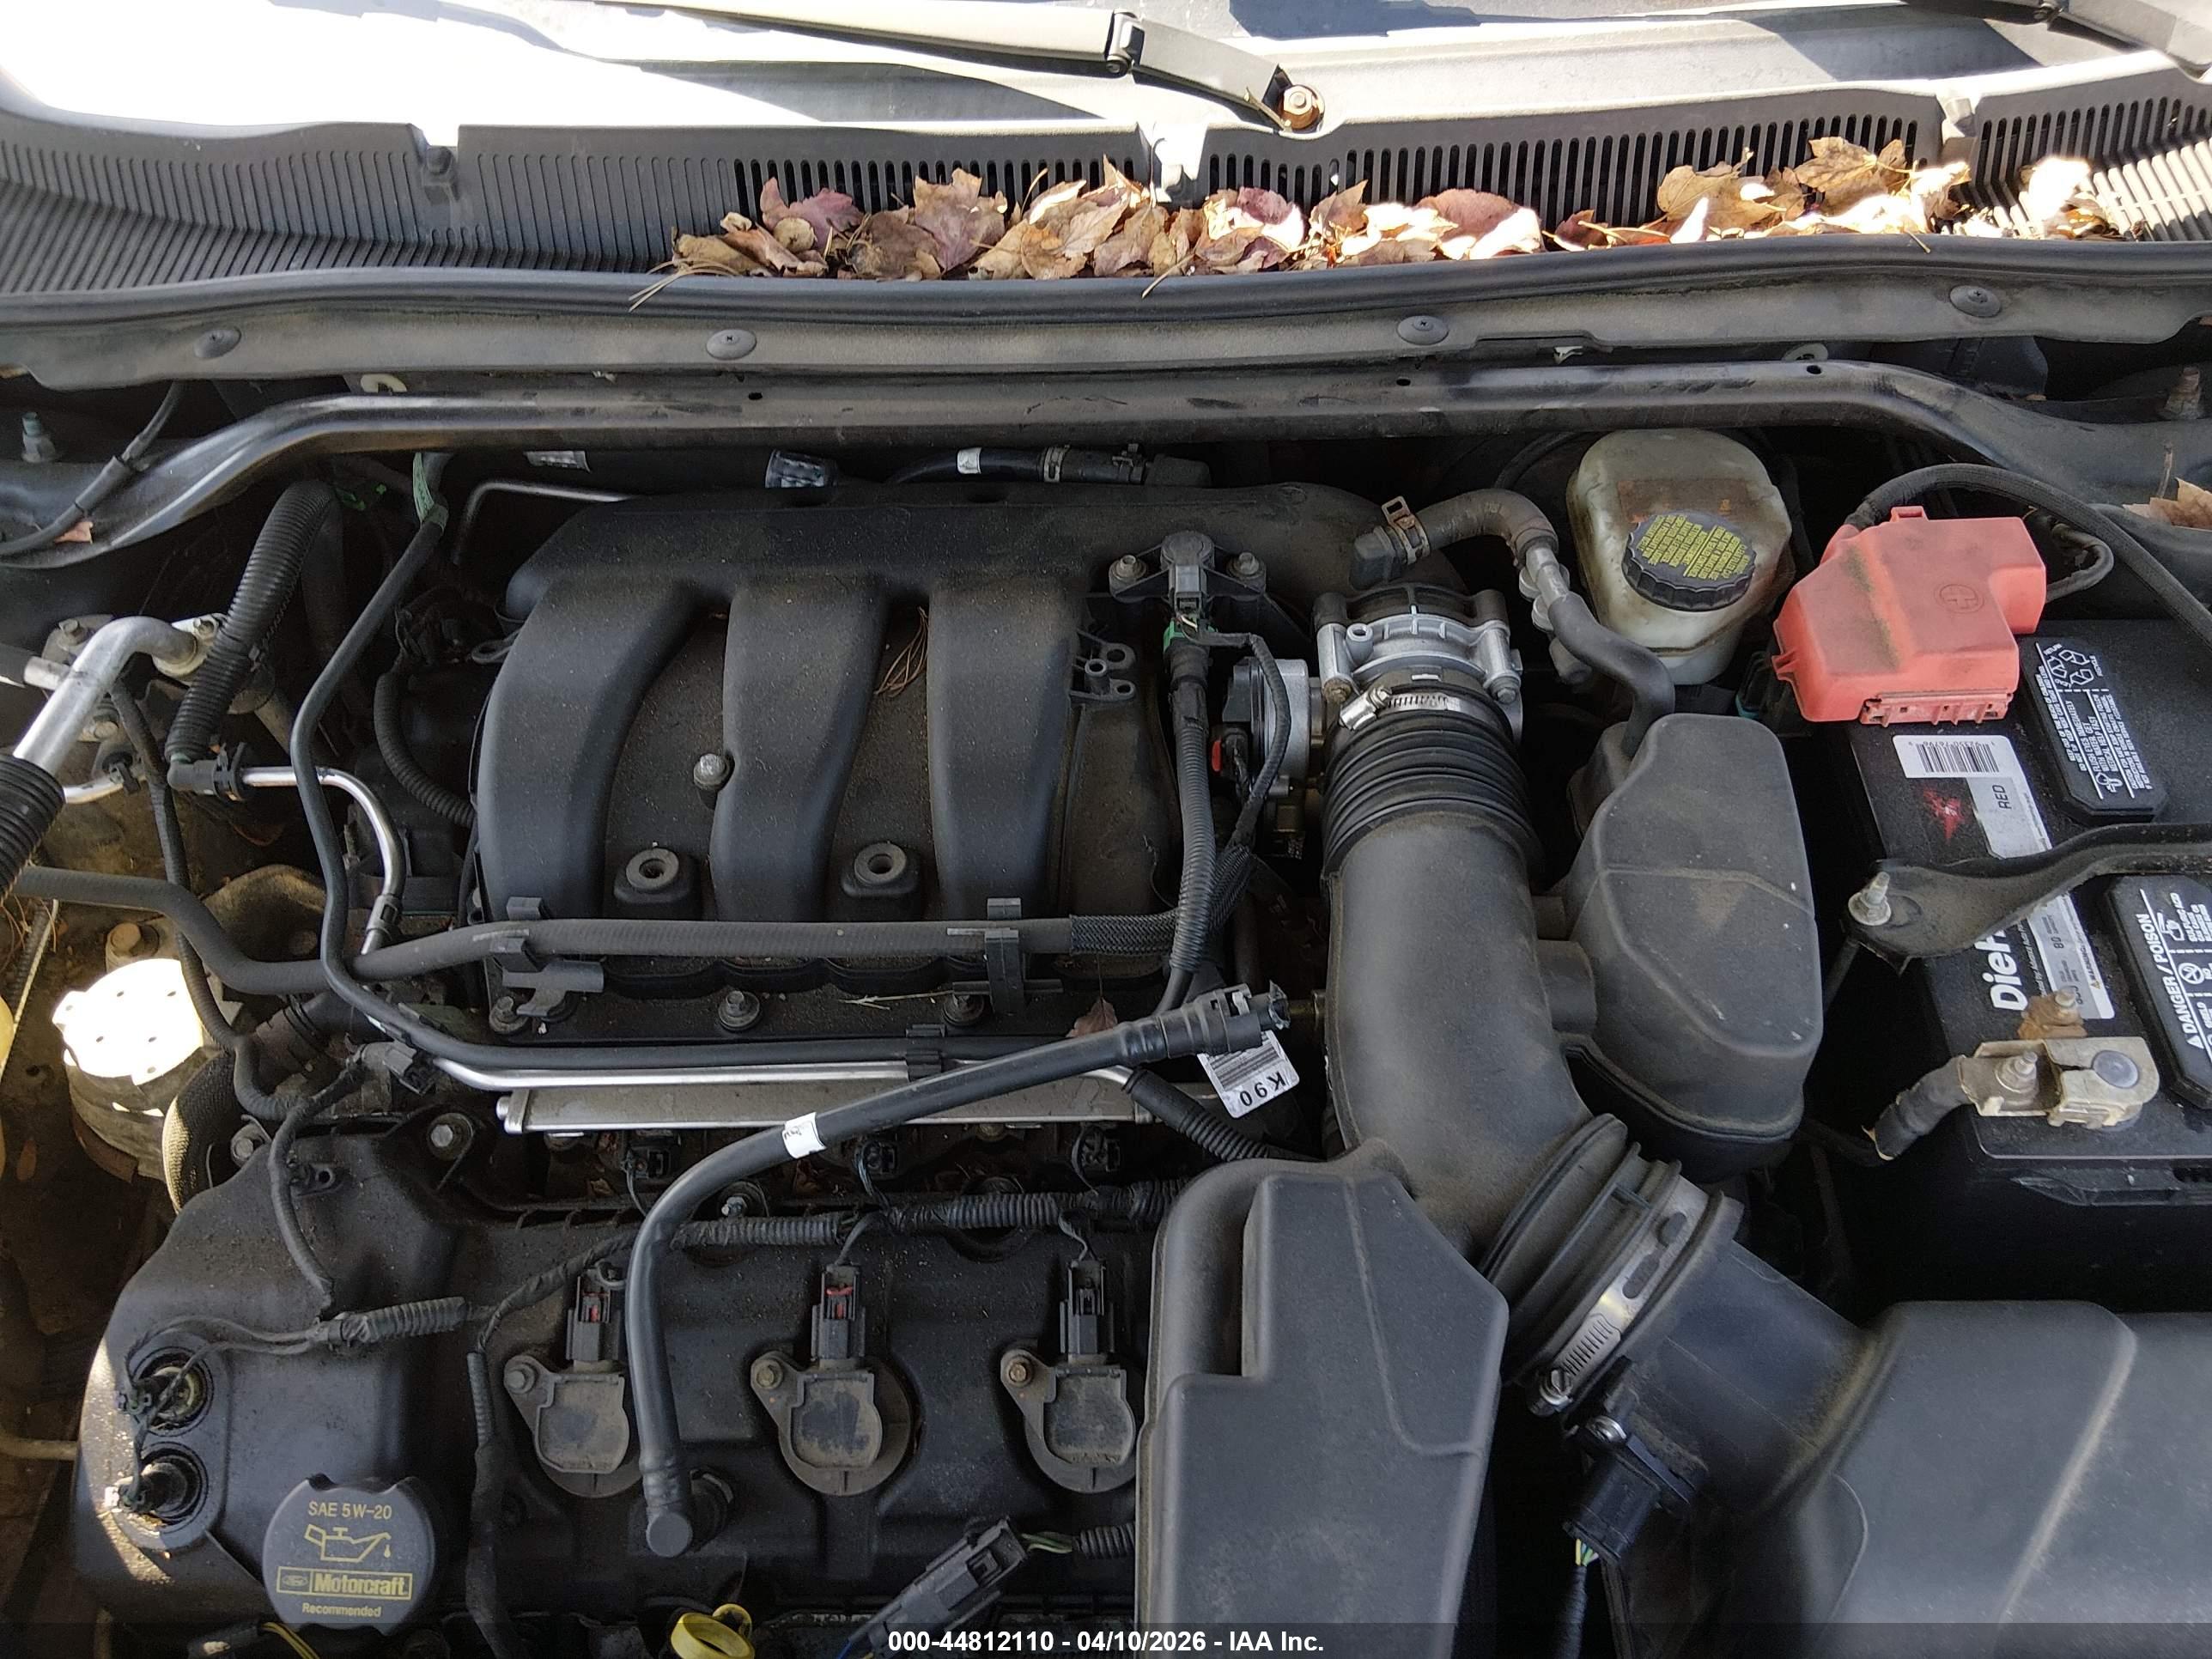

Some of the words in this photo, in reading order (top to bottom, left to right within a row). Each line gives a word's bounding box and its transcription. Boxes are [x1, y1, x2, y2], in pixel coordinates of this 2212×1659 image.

[2066, 701, 2086, 736] IMMEDIATELY
[2088, 716, 2100, 730] FAST
[2082, 723, 2093, 734] GET
[2081, 737, 2092, 752] EYES
[2095, 732, 2107, 746] HELP
[2087, 753, 2101, 772] FLUSH
[2098, 757, 2109, 772] WITH
[2102, 747, 2118, 772] MEDICAL
[1992, 784, 2011, 810] RED
[2051, 936, 2064, 949] 80
[1974, 928, 2028, 1009] DieH
[309, 1501, 338, 1516] SAE
[342, 1503, 392, 1520] 5W-20
[314, 1572, 406, 1596] Motorcraft
[302, 1602, 381, 1617] Recommended
